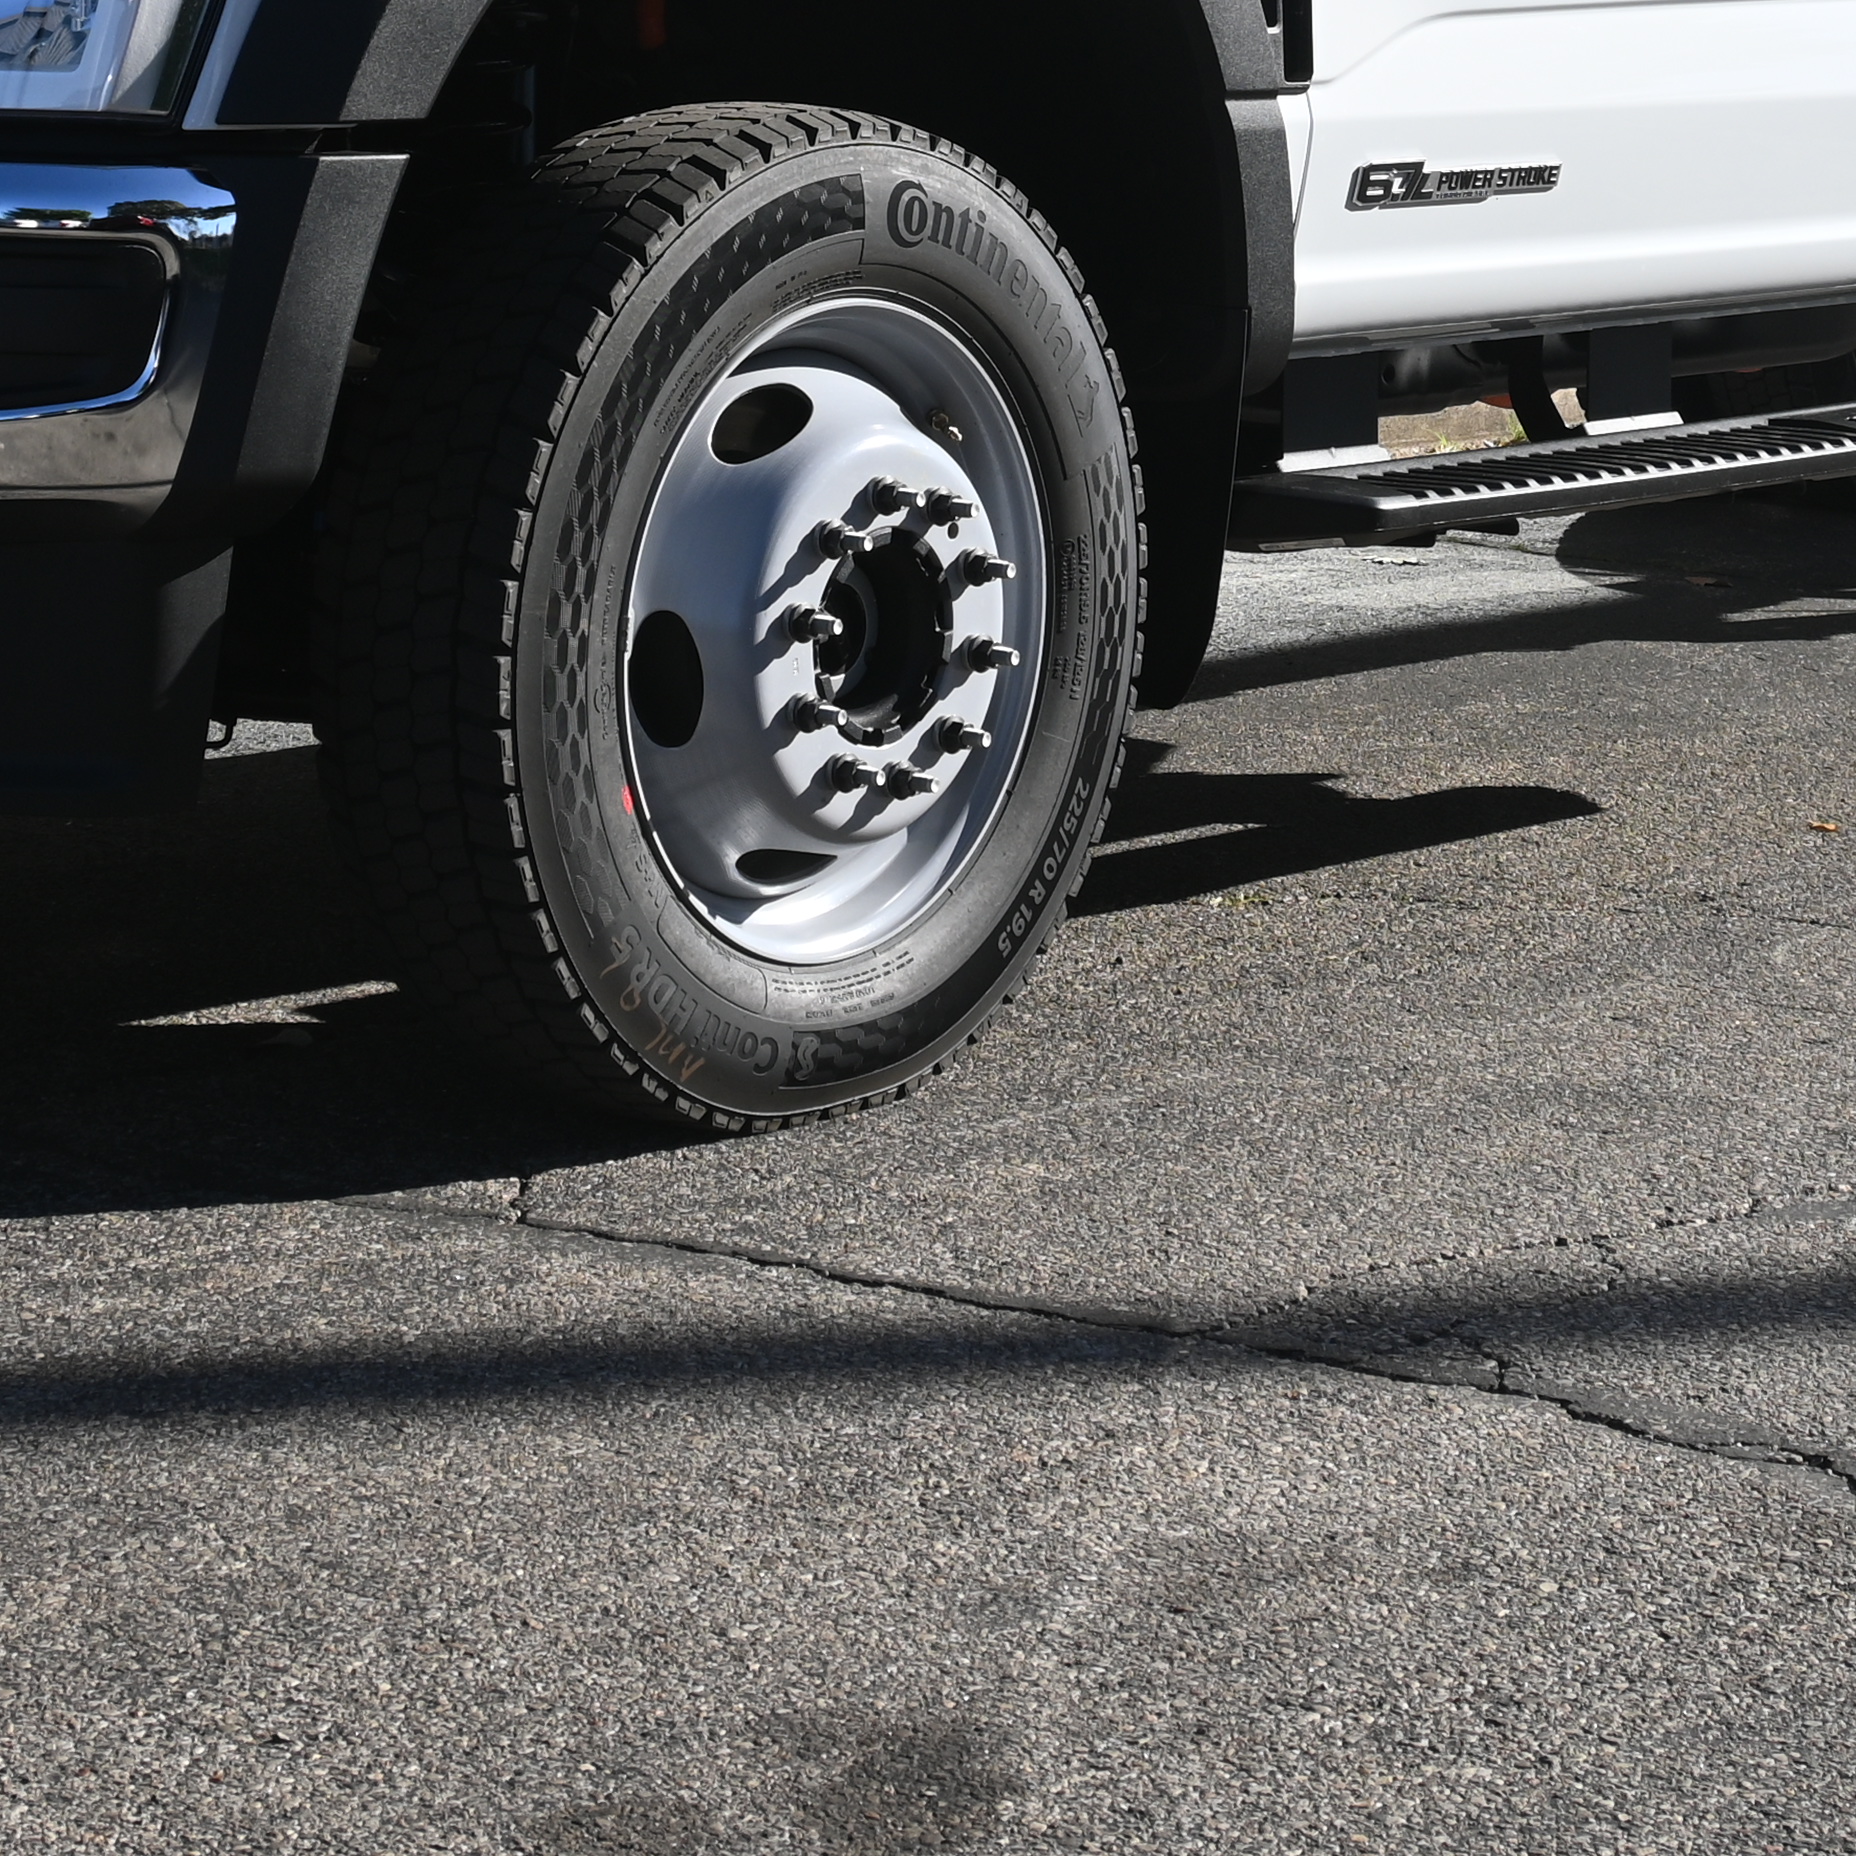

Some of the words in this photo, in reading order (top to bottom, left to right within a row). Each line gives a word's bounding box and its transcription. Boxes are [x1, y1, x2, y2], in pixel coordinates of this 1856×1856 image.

[1354, 163, 1434, 205] 6.7L
[1437, 170, 1493, 192] POWER
[1496, 165, 1558, 188] STROKE
[887, 180, 1087, 390] Continental
[1043, 777, 1090, 880] 225/70
[1029, 879, 1046, 905] R
[998, 903, 1033, 958] 19.5
[692, 1009, 779, 1076] Conti
